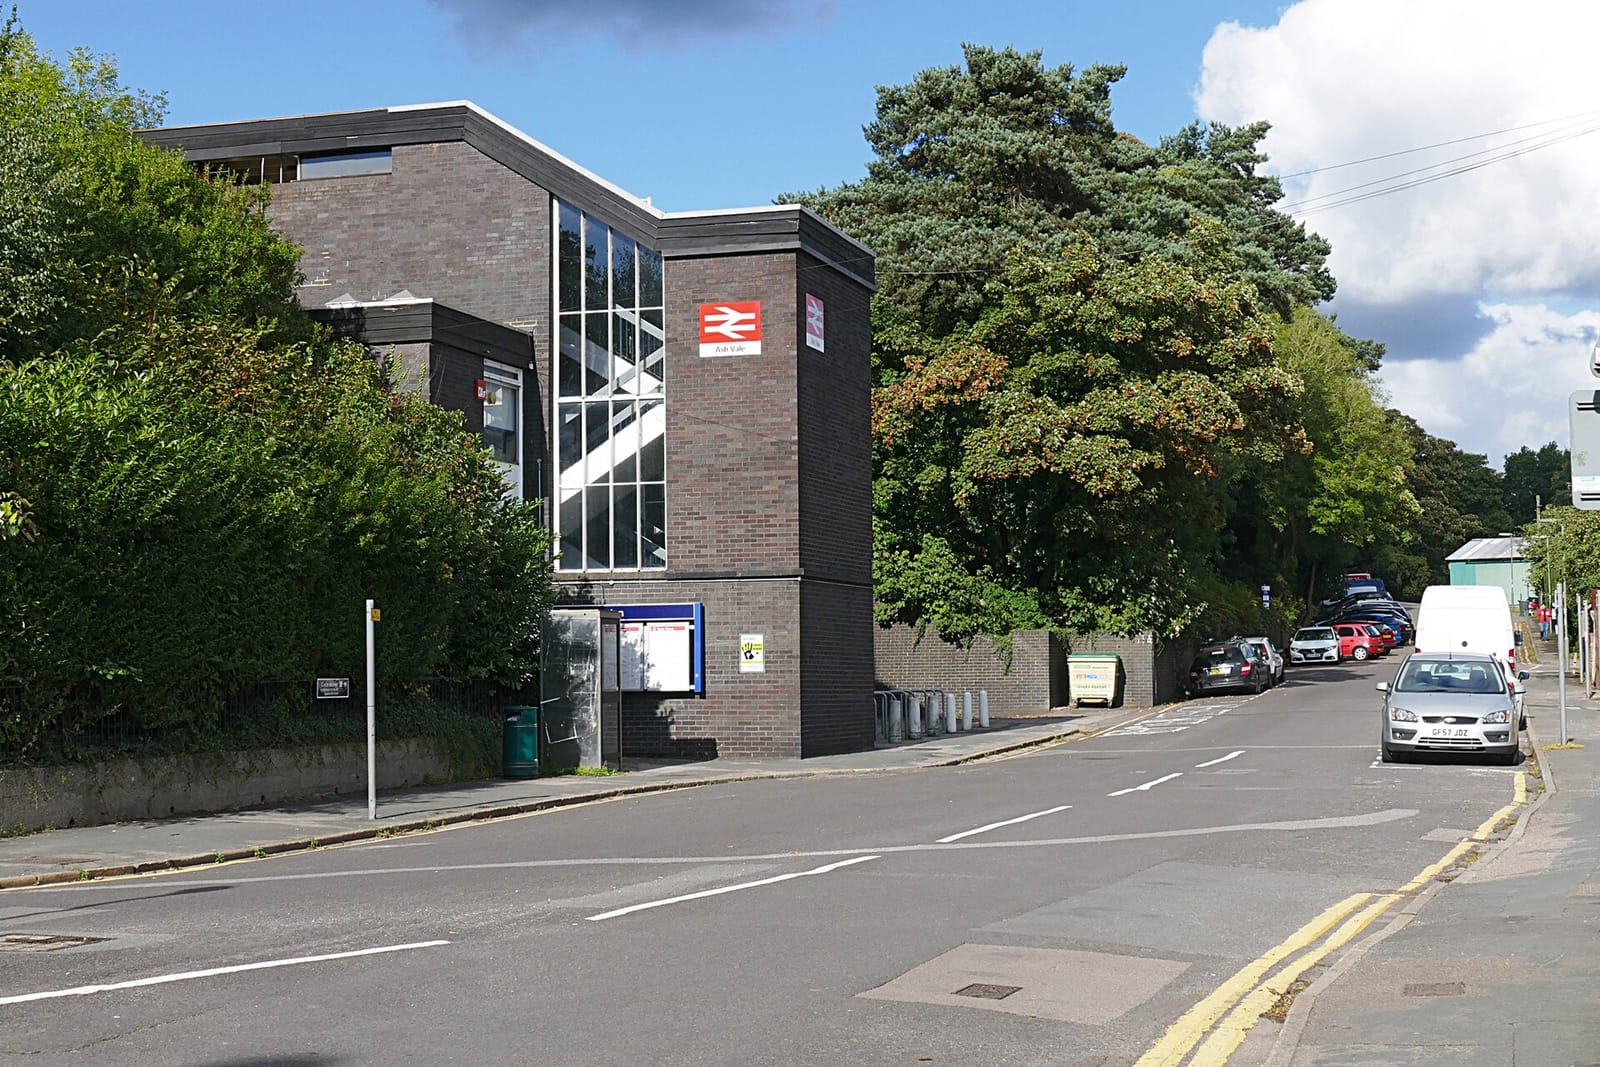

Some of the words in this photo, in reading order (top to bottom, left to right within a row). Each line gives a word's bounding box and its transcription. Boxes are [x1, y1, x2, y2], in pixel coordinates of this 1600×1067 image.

[715, 345, 729, 353] Ash
[730, 344, 746, 353] Vale
[1432, 728, 1452, 736] GF57
[1454, 729, 1468, 737] JDZ
